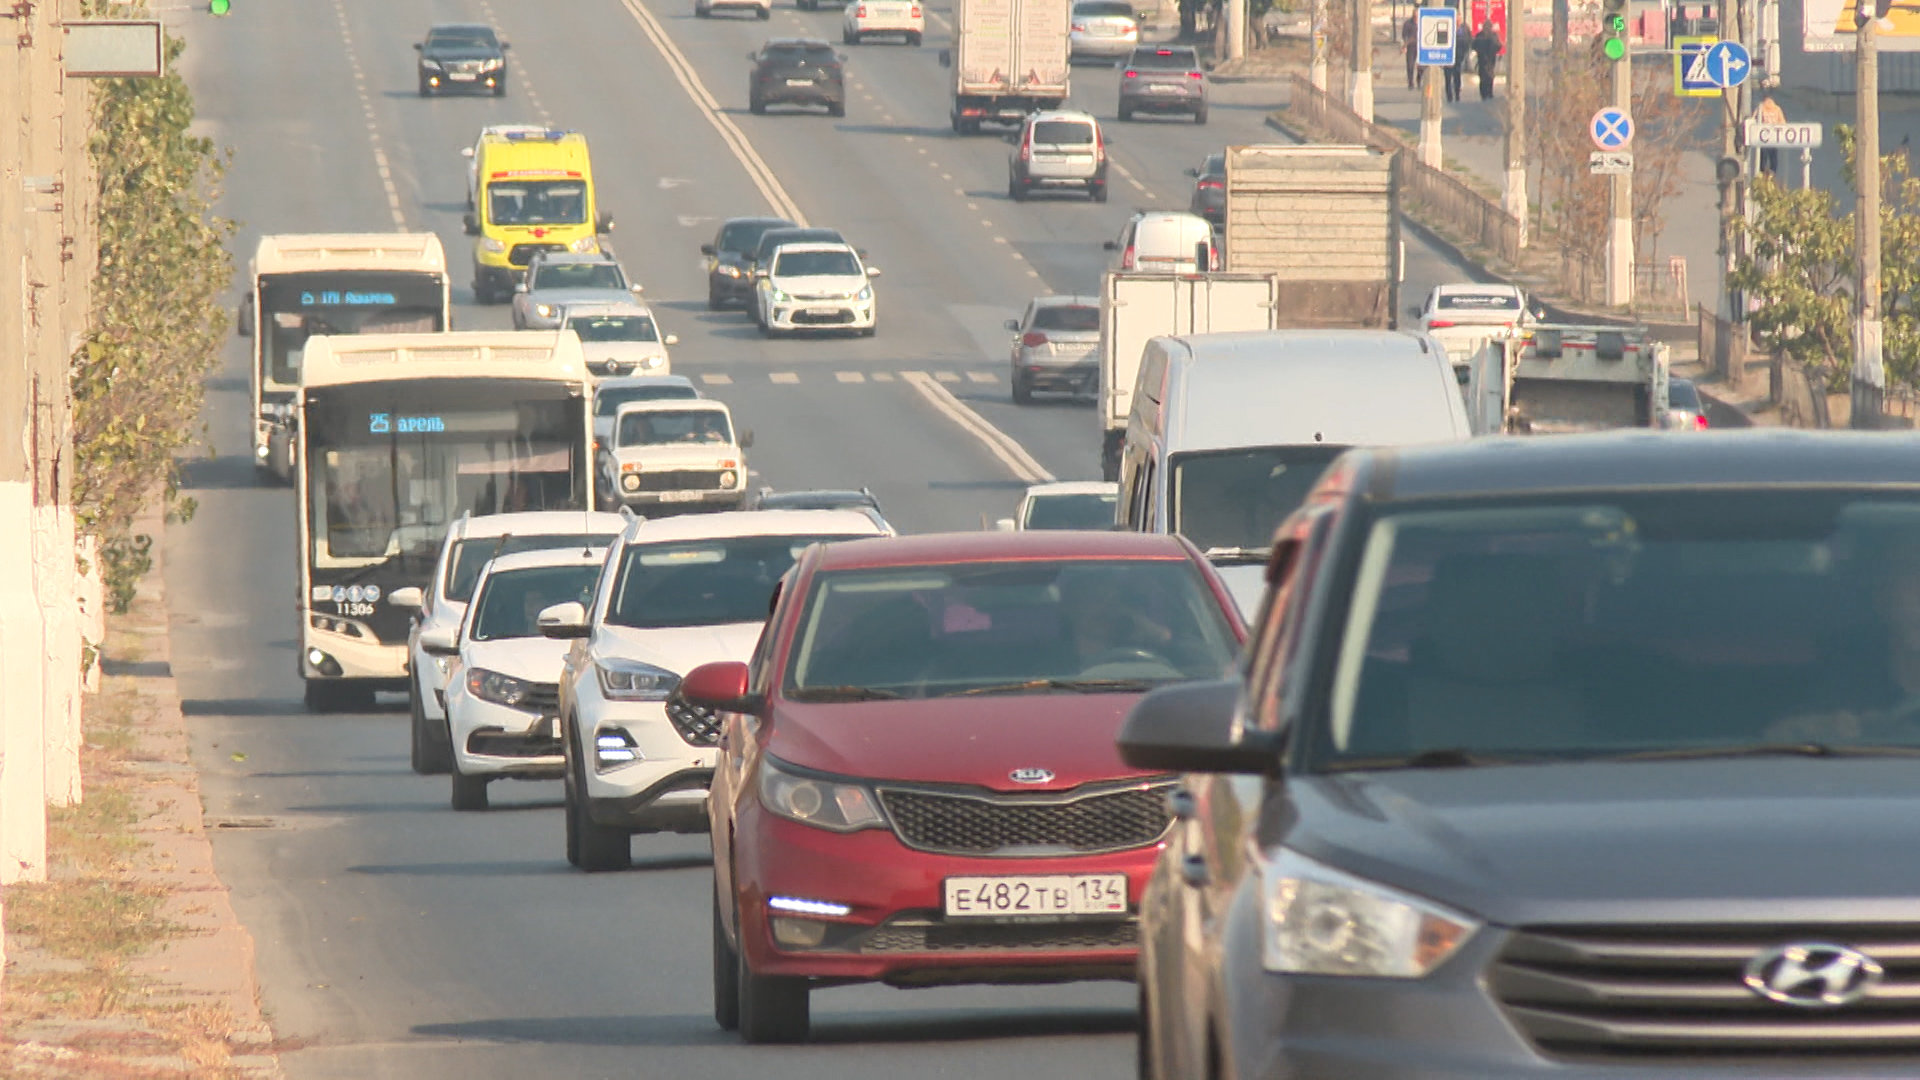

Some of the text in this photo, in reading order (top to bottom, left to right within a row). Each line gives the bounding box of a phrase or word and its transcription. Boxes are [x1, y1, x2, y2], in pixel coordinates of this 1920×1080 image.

[1759, 127, 1811, 144] СТОП
[369, 413, 389, 433] 25
[337, 602, 374, 616] 11306
